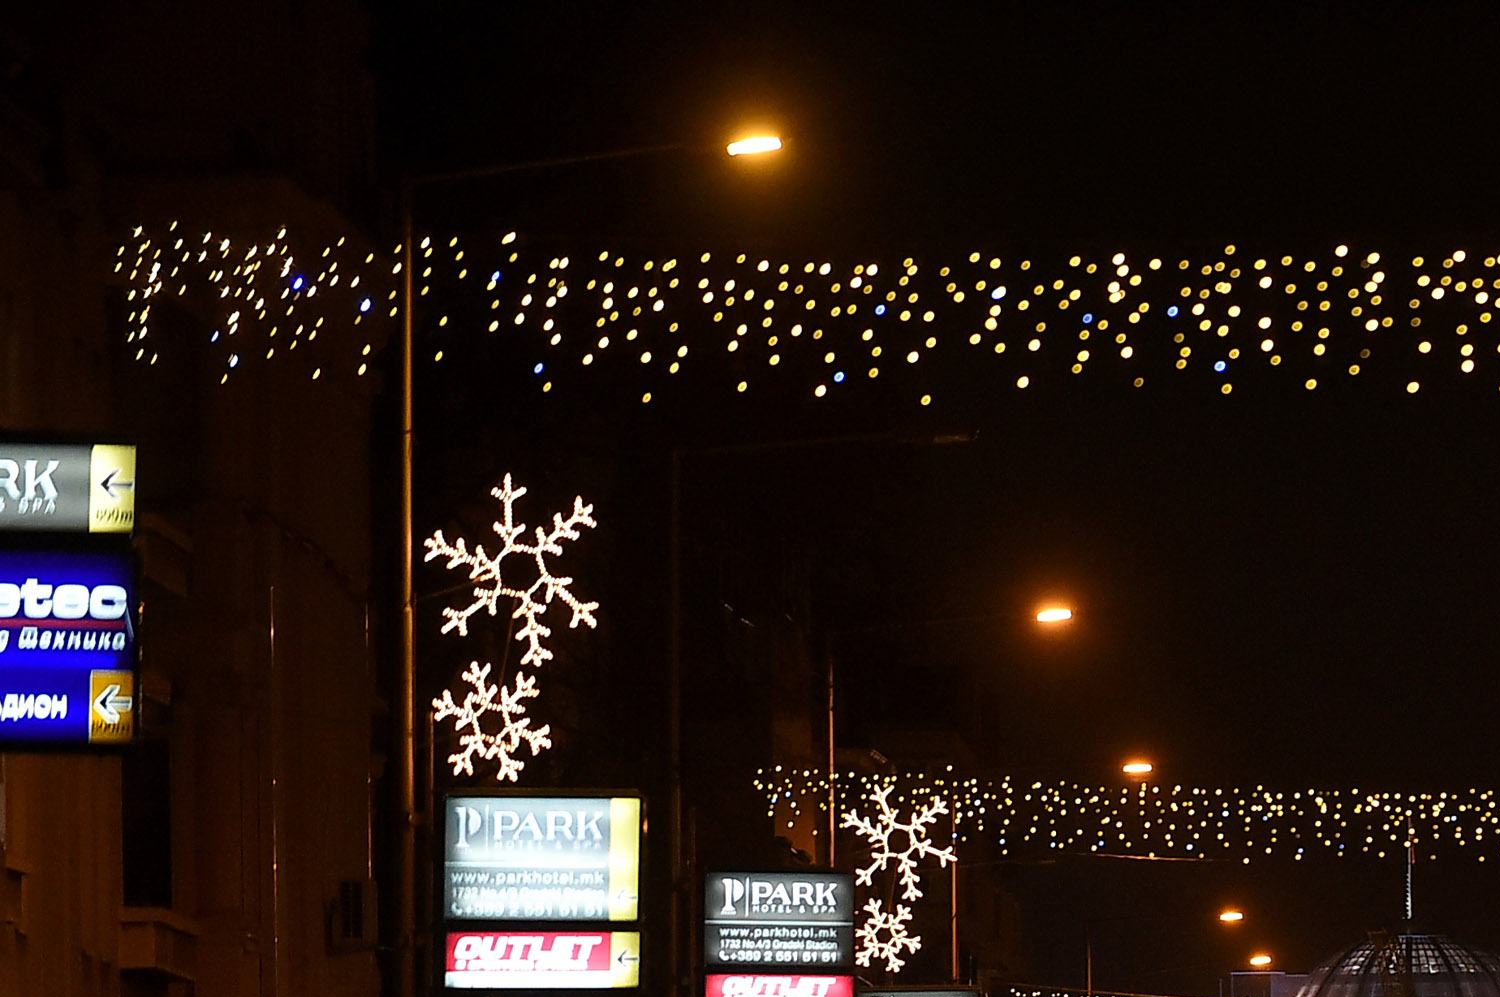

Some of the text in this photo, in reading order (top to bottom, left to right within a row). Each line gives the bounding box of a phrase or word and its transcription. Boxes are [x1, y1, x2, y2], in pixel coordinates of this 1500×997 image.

[493, 811, 603, 841] PARK
[451, 871, 604, 886] www.parkhotel.mk
[752, 881, 838, 906] PARK
[752, 905, 792, 913] HOTEL
[813, 906, 836, 914] SPA
[719, 927, 838, 939] www.parkhotel.mk
[454, 935, 603, 960] OUTLET
[764, 951, 773, 962] 2
[722, 976, 837, 996] OUTLET
